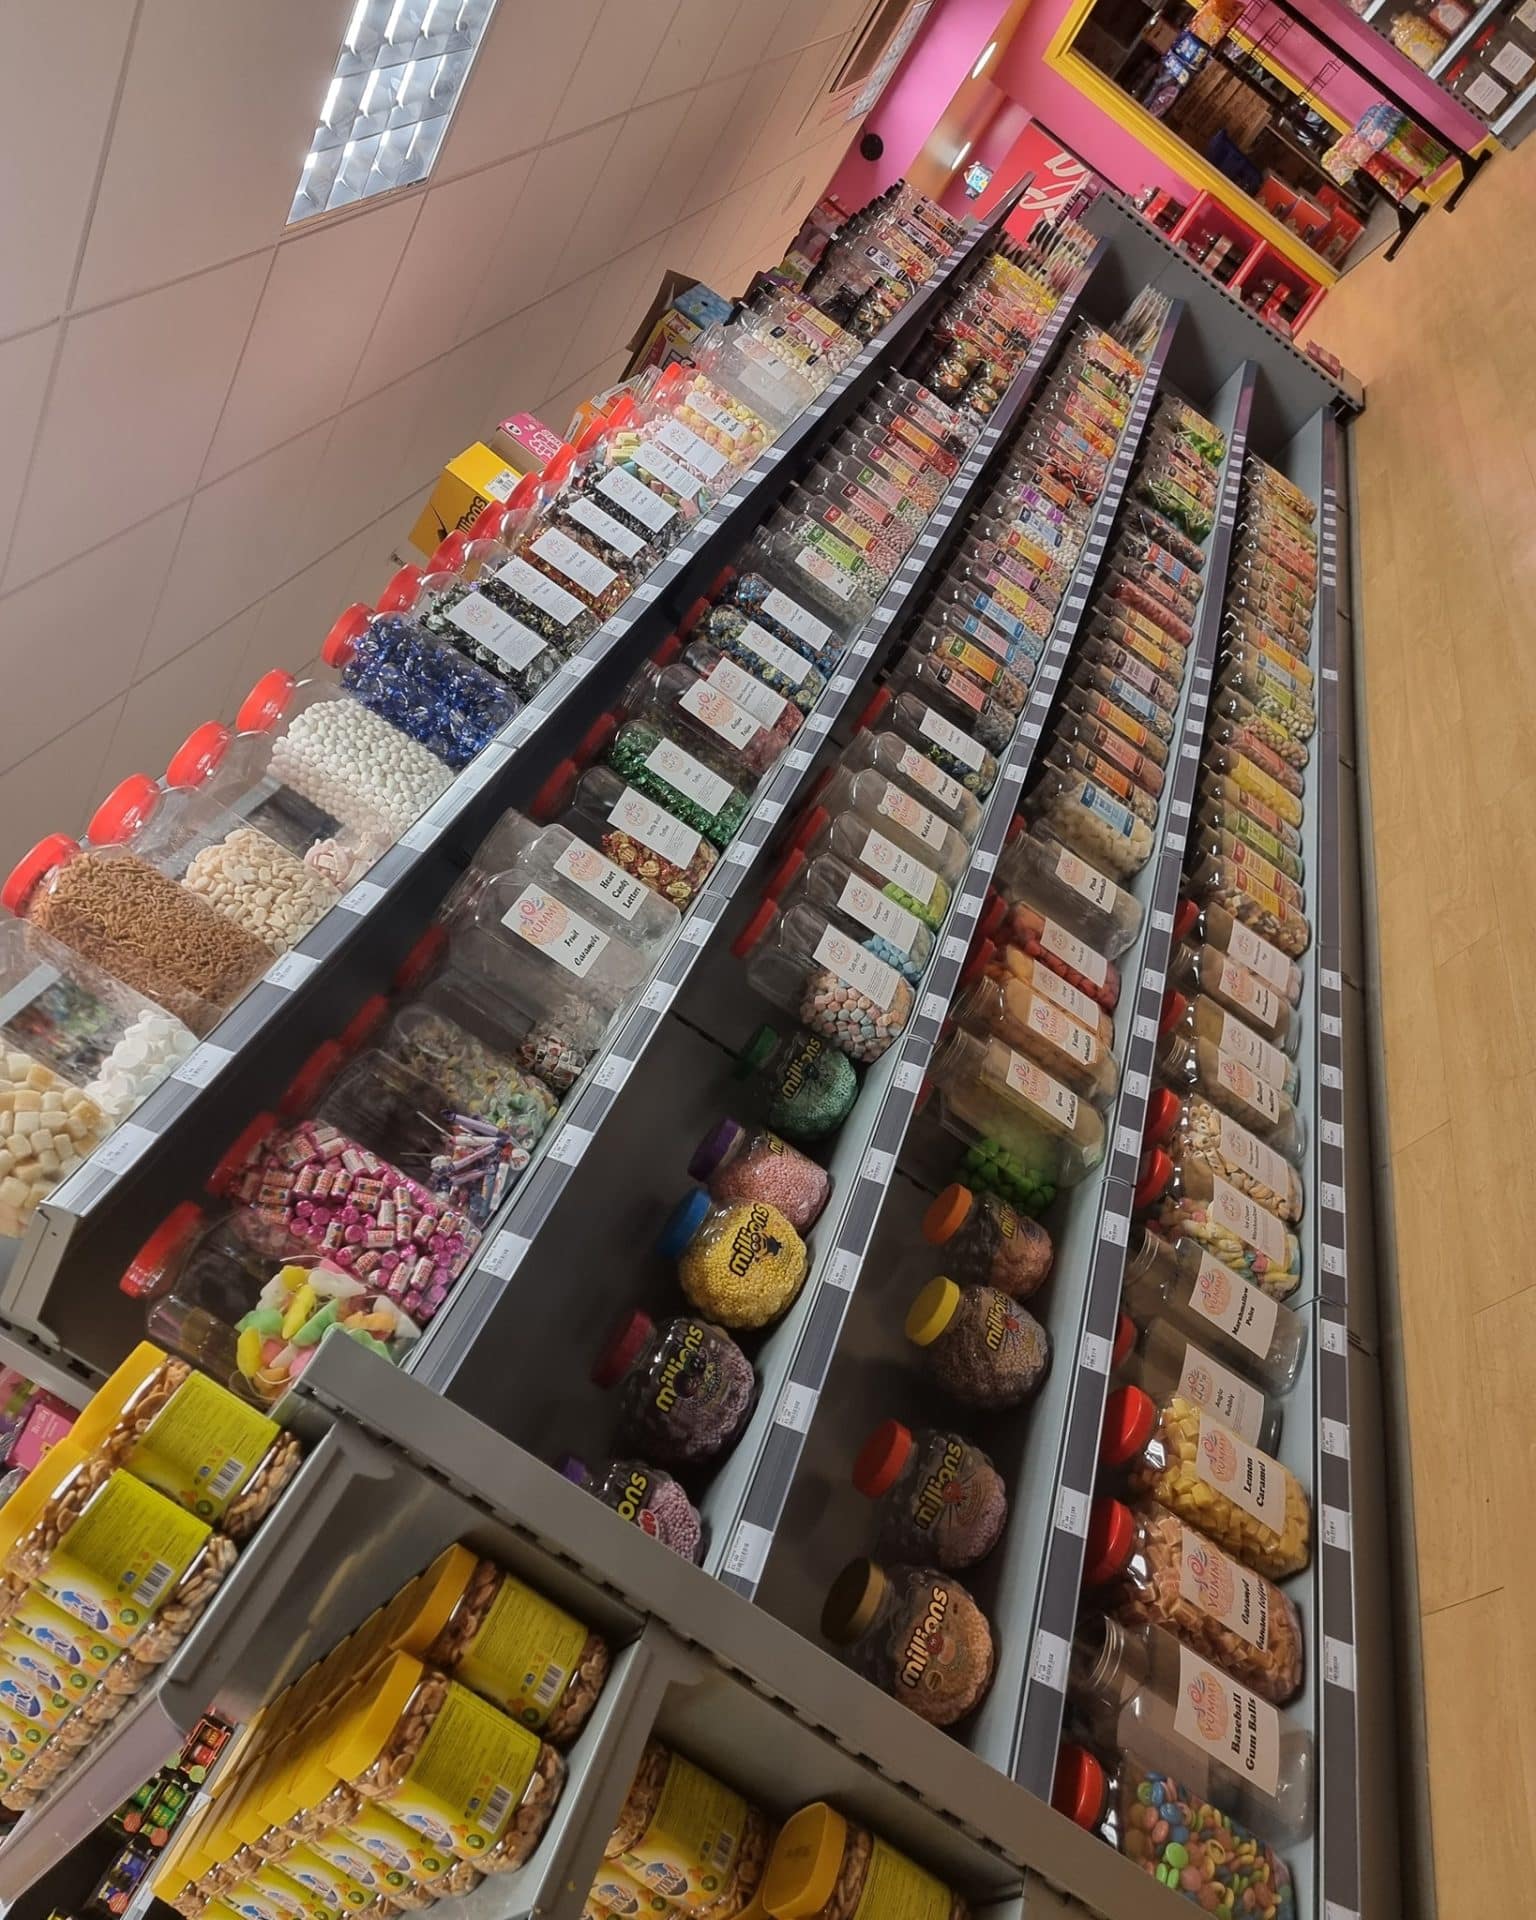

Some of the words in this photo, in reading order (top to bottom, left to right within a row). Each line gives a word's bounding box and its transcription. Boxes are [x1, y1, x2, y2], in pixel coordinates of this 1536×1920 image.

[600, 870, 617, 890] Heart
[612, 878, 630, 898] Candy
[622, 886, 642, 909] Letters
[527, 904, 561, 939] YUMMY
[564, 929, 580, 948] Fruit
[574, 933, 601, 966] Caramels
[781, 1037, 821, 1100] millions
[729, 1202, 770, 1277] millions
[1232, 1287, 1248, 1336] Marshmallow
[1245, 1307, 1255, 1326] Poles
[655, 1325, 704, 1412] millions
[914, 1441, 962, 1530] millions
[1243, 1457, 1253, 1494] Lemon
[1256, 1461, 1266, 1507] Caramel
[1207, 1555, 1222, 1608] YUMMY
[1241, 1578, 1252, 1625] Caramel
[902, 1586, 948, 1688] millions
[1206, 1679, 1218, 1733] YUMMY
[1231, 1692, 1242, 1754] Baseball
[1248, 1697, 1257, 1733] Balls
[1246, 1735, 1257, 1771] Gum
